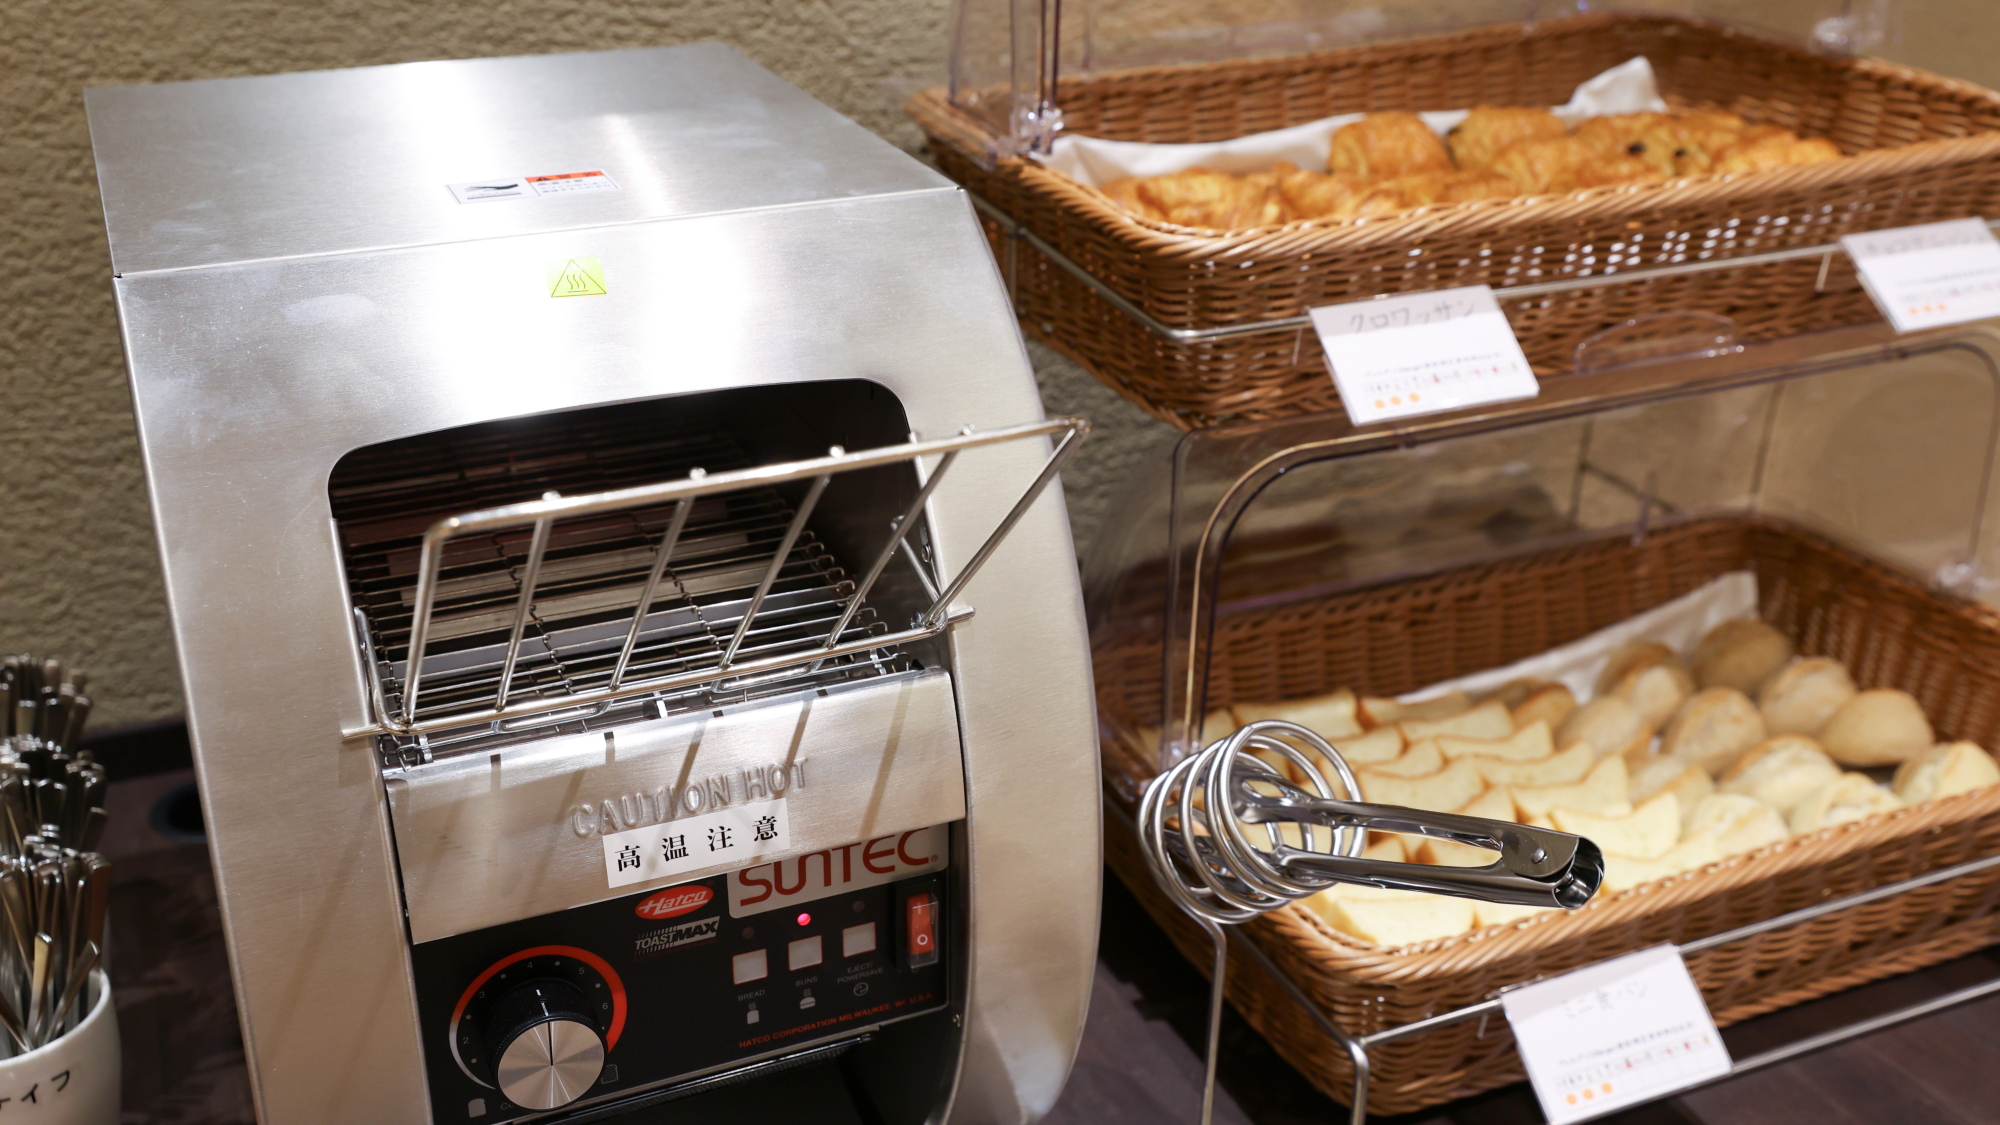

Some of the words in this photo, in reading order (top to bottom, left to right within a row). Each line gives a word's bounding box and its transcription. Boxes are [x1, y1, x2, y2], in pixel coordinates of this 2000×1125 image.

[570, 774, 731, 838] CAUTION
[742, 757, 808, 801] HOT
[614, 815, 778, 872] 高温注意
[638, 890, 709, 916] Hatco
[526, 961, 533, 969] 4
[578, 967, 585, 975] 5
[795, 975, 818, 987] BUNS
[836, 966, 884, 984] POWERSAVE
[478, 991, 486, 999] 3
[737, 989, 766, 1002] BREAD
[602, 1002, 609, 1010] 6
[738, 1034, 771, 1049] HATCO
[772, 1017, 837, 1040] CORPORATION
[462, 1036, 469, 1045] 2
